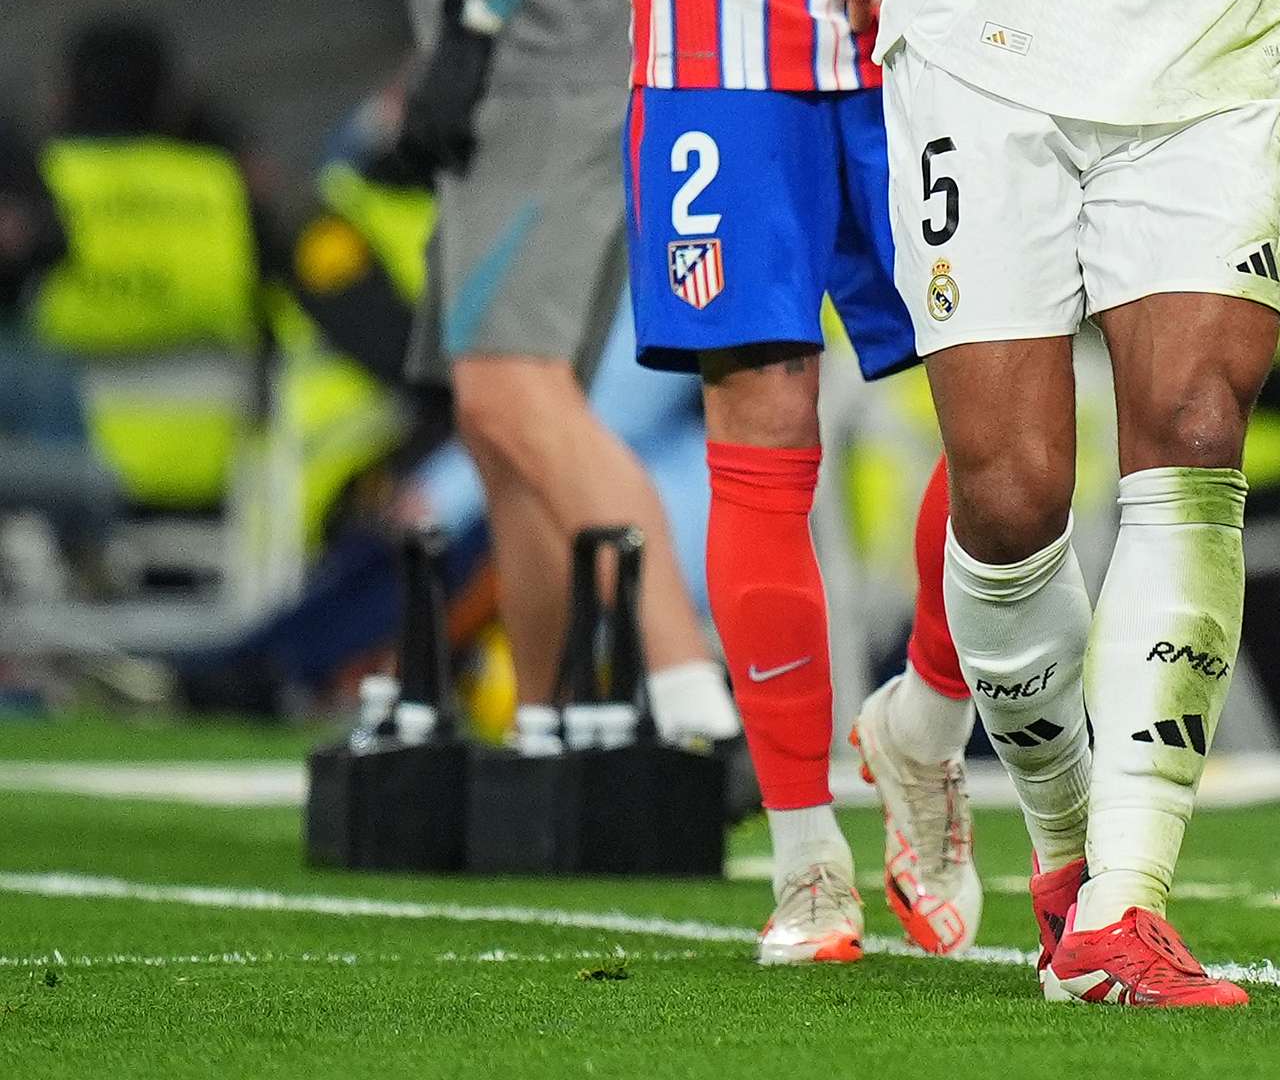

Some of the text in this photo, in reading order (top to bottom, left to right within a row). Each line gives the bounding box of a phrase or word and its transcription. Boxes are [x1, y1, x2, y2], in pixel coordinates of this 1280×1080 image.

[670, 130, 722, 236] 2
[921, 136, 960, 246] 5
[976, 662, 1058, 700] RMCF
[1146, 641, 1231, 680] RMCF
